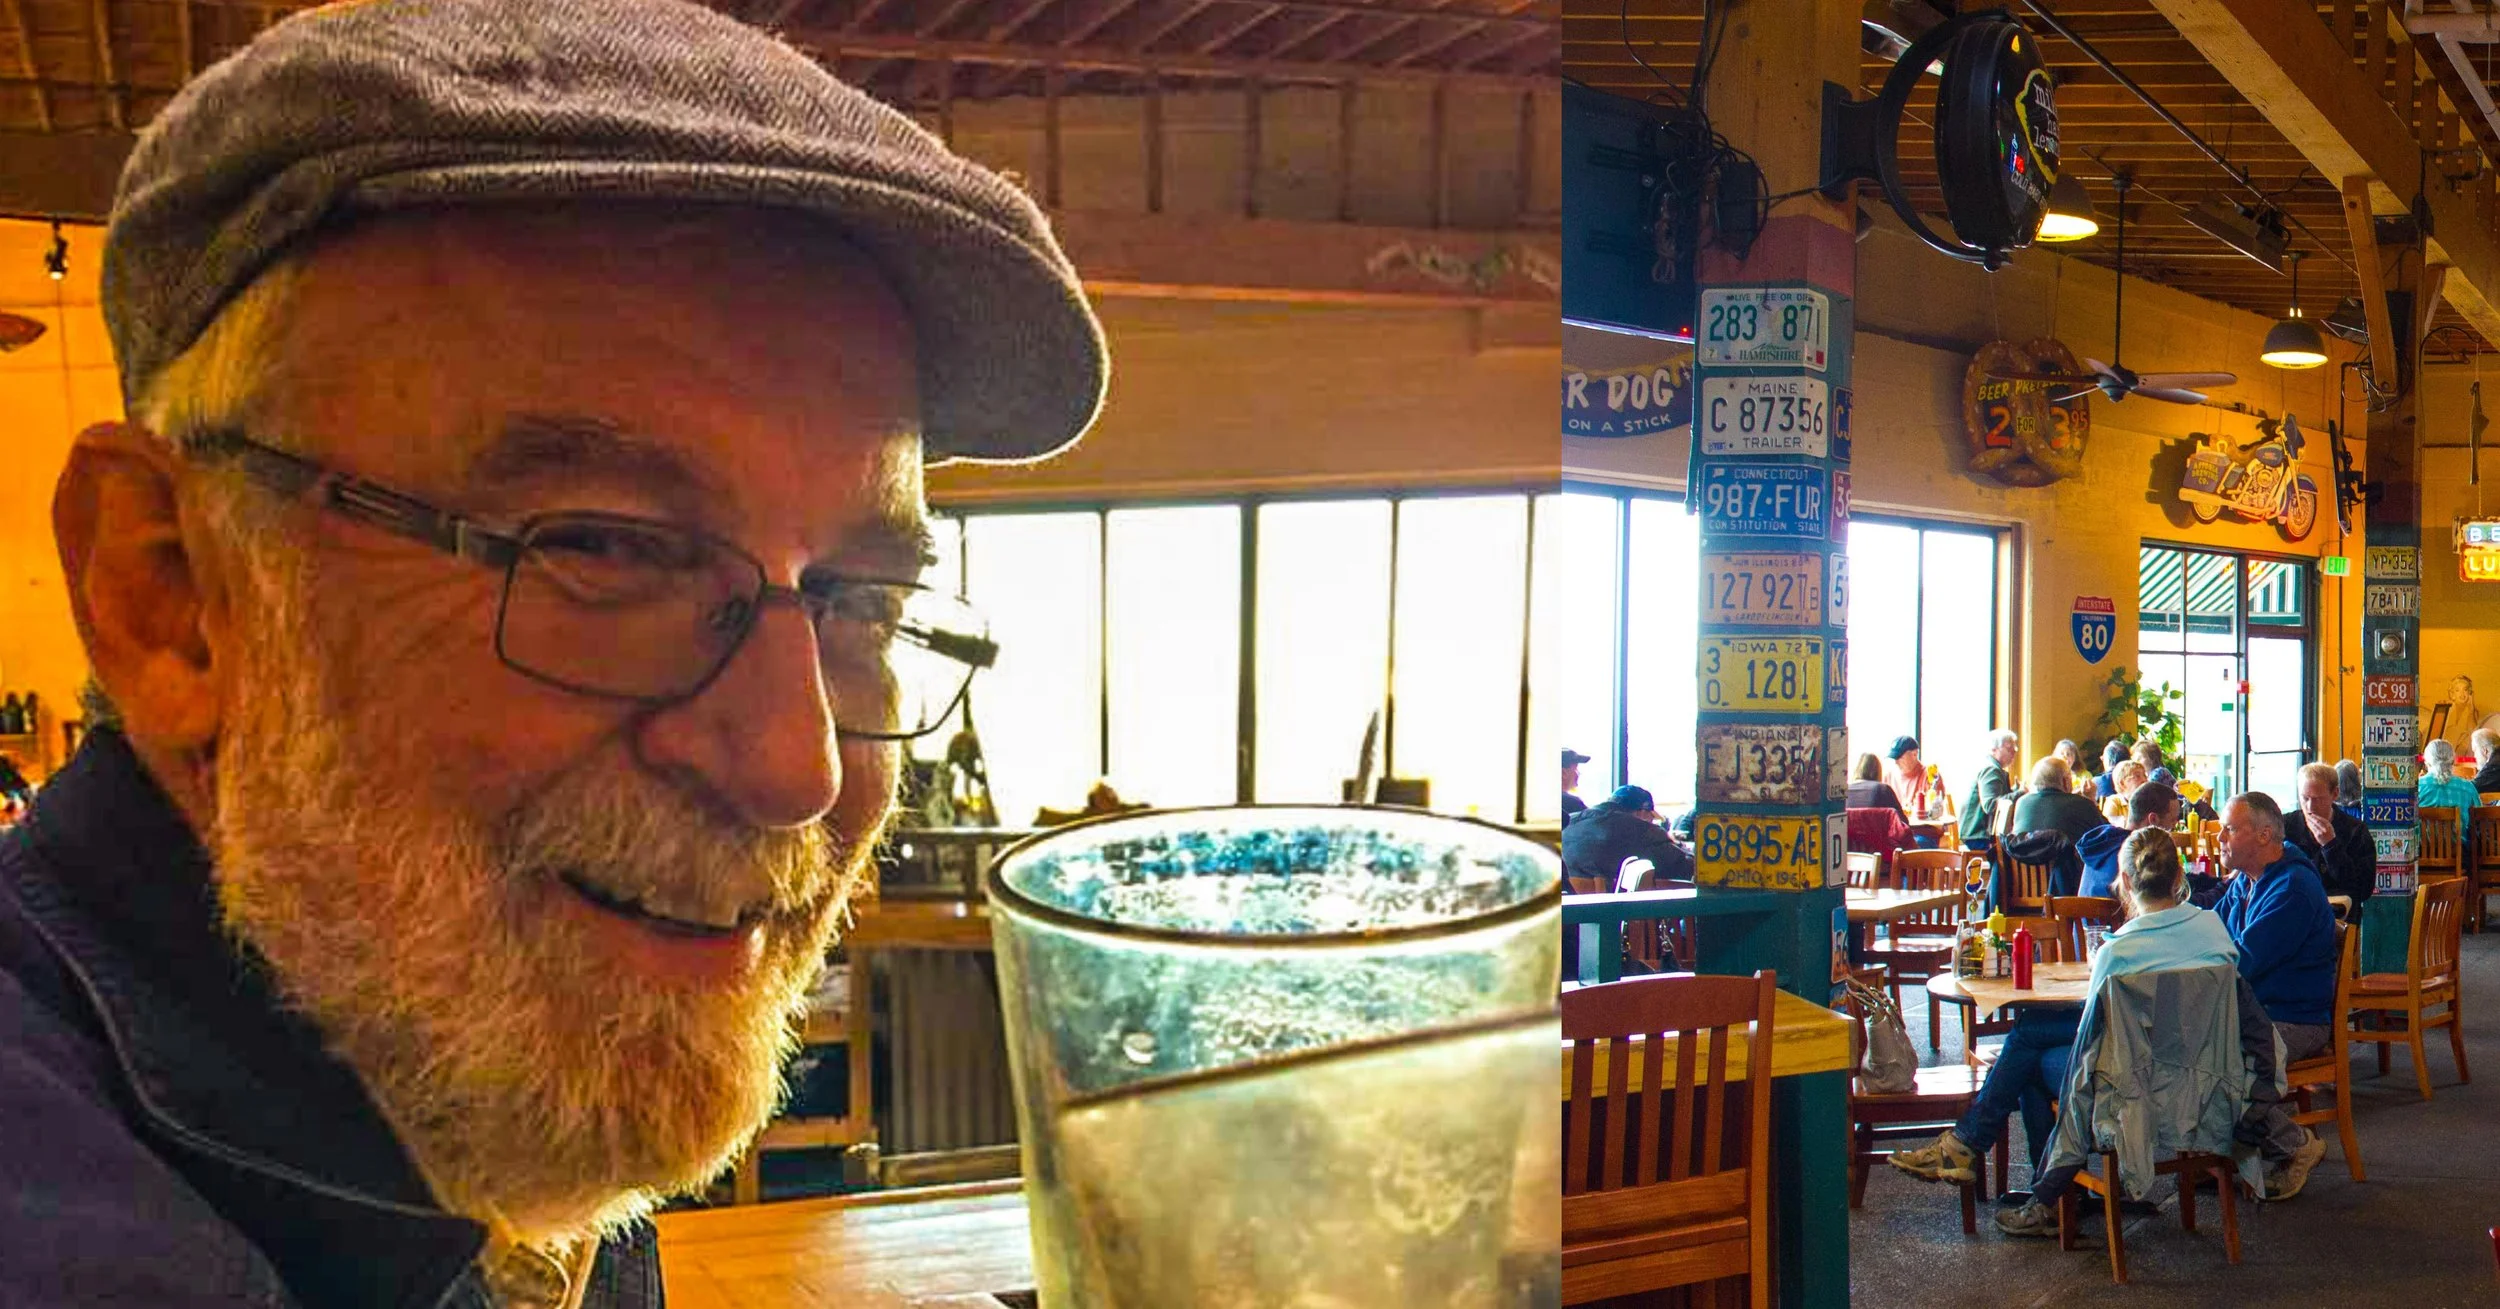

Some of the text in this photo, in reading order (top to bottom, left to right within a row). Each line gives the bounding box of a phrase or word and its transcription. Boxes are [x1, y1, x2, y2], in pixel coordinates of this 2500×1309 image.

[1780, 293, 1792, 301] OR
[1709, 304, 1820, 345] 283 871
[1739, 350, 1801, 361] HAMPSHIRE
[1567, 368, 1674, 410] R DOG
[1748, 383, 1798, 395] MAINE
[1977, 382, 2010, 401] BEER
[1568, 413, 1672, 433] ON A STICK
[1711, 397, 1823, 435] C 87356
[1985, 405, 2012, 449] 2
[2016, 416, 2035, 433] FOR
[1743, 437, 1802, 449] TRAILER
[1734, 468, 1809, 480] CONNECTICUT
[1752, 558, 1789, 567] ILLINOIS
[2328, 556, 2347, 573] EXIT
[2469, 555, 2500, 572] LU
[1708, 572, 1753, 610] 127
[1762, 573, 1808, 610] 927
[2077, 600, 2112, 610] INTERSTATE
[2081, 623, 2108, 651] 80
[1731, 641, 1803, 653] IOWA 72
[1746, 660, 1809, 700] 1281
[2368, 682, 2388, 699] CC
[1735, 728, 1800, 741] INDIANA
[2369, 805, 2391, 822] 322
[1833, 834, 1842, 869] D
[1726, 868, 1762, 884] OHIO
